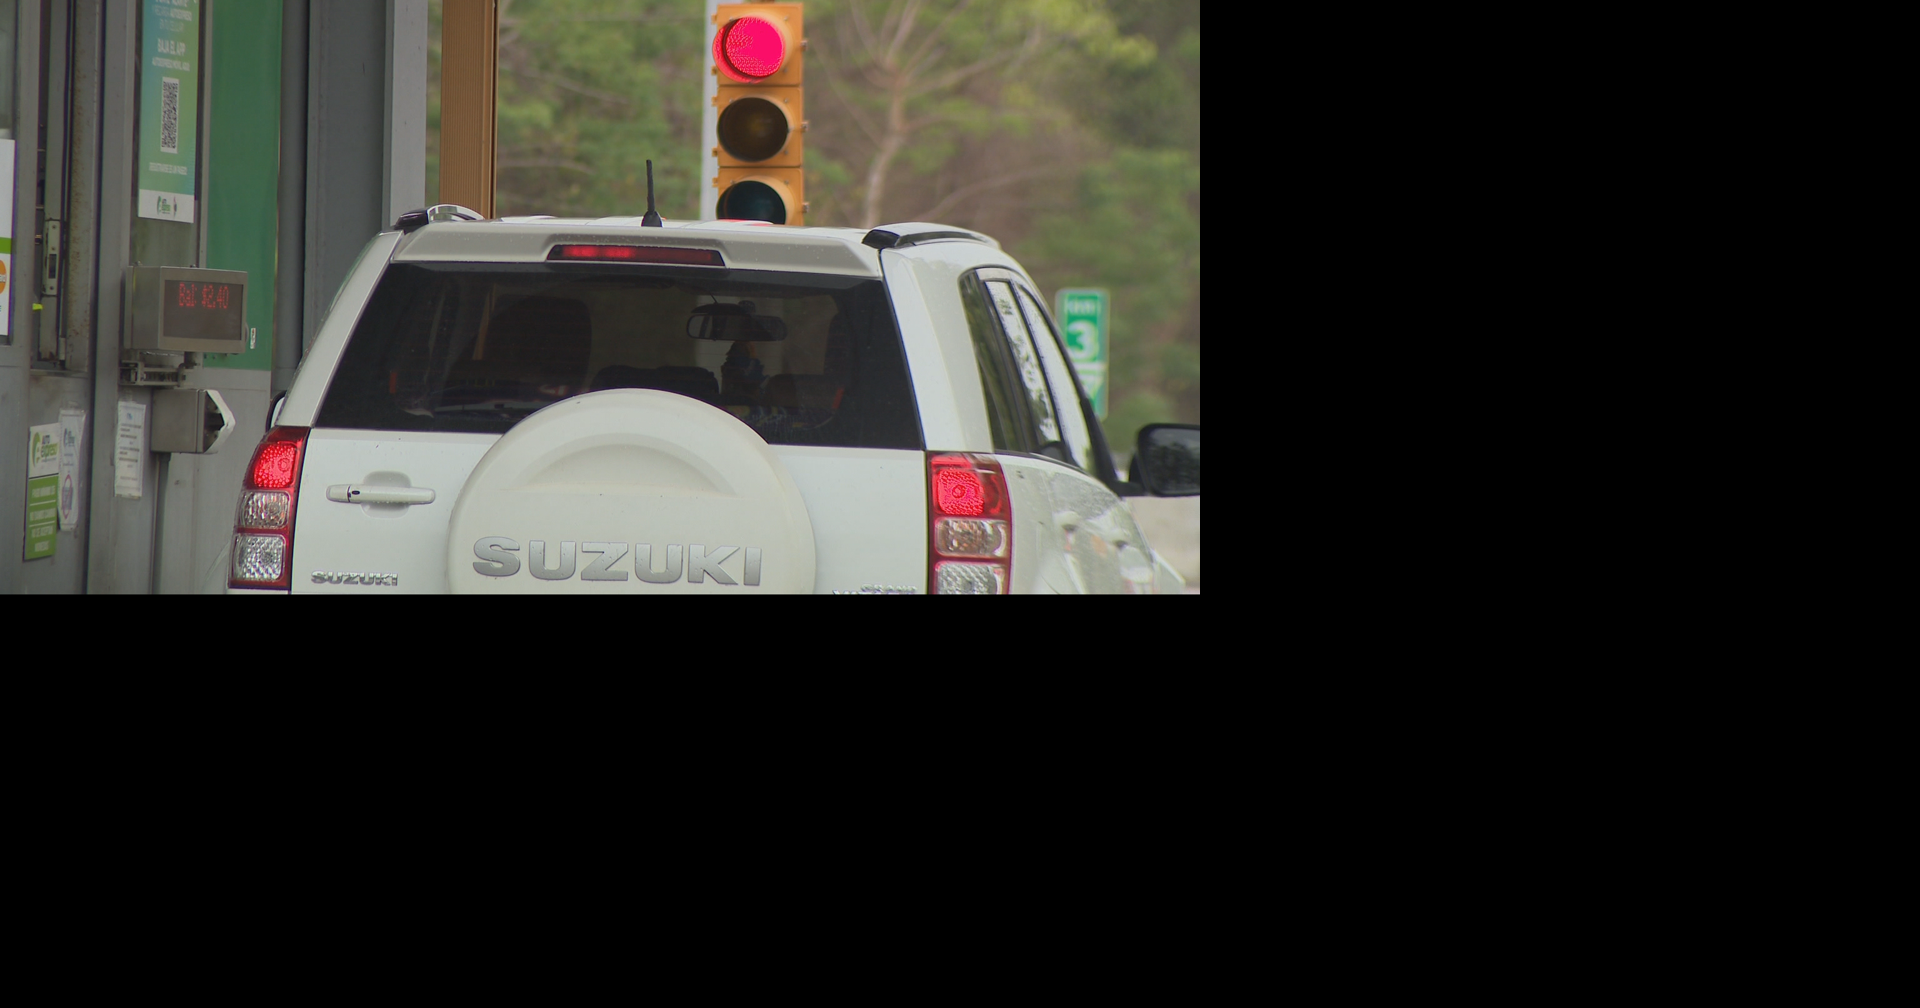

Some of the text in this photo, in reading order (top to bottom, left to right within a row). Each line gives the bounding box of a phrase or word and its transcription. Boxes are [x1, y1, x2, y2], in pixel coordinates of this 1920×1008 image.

[202, 284, 230, 309] $2.40
[1066, 320, 1099, 360] 3
[473, 536, 762, 586] SUZUKI
[310, 570, 398, 586] SUZUKI
